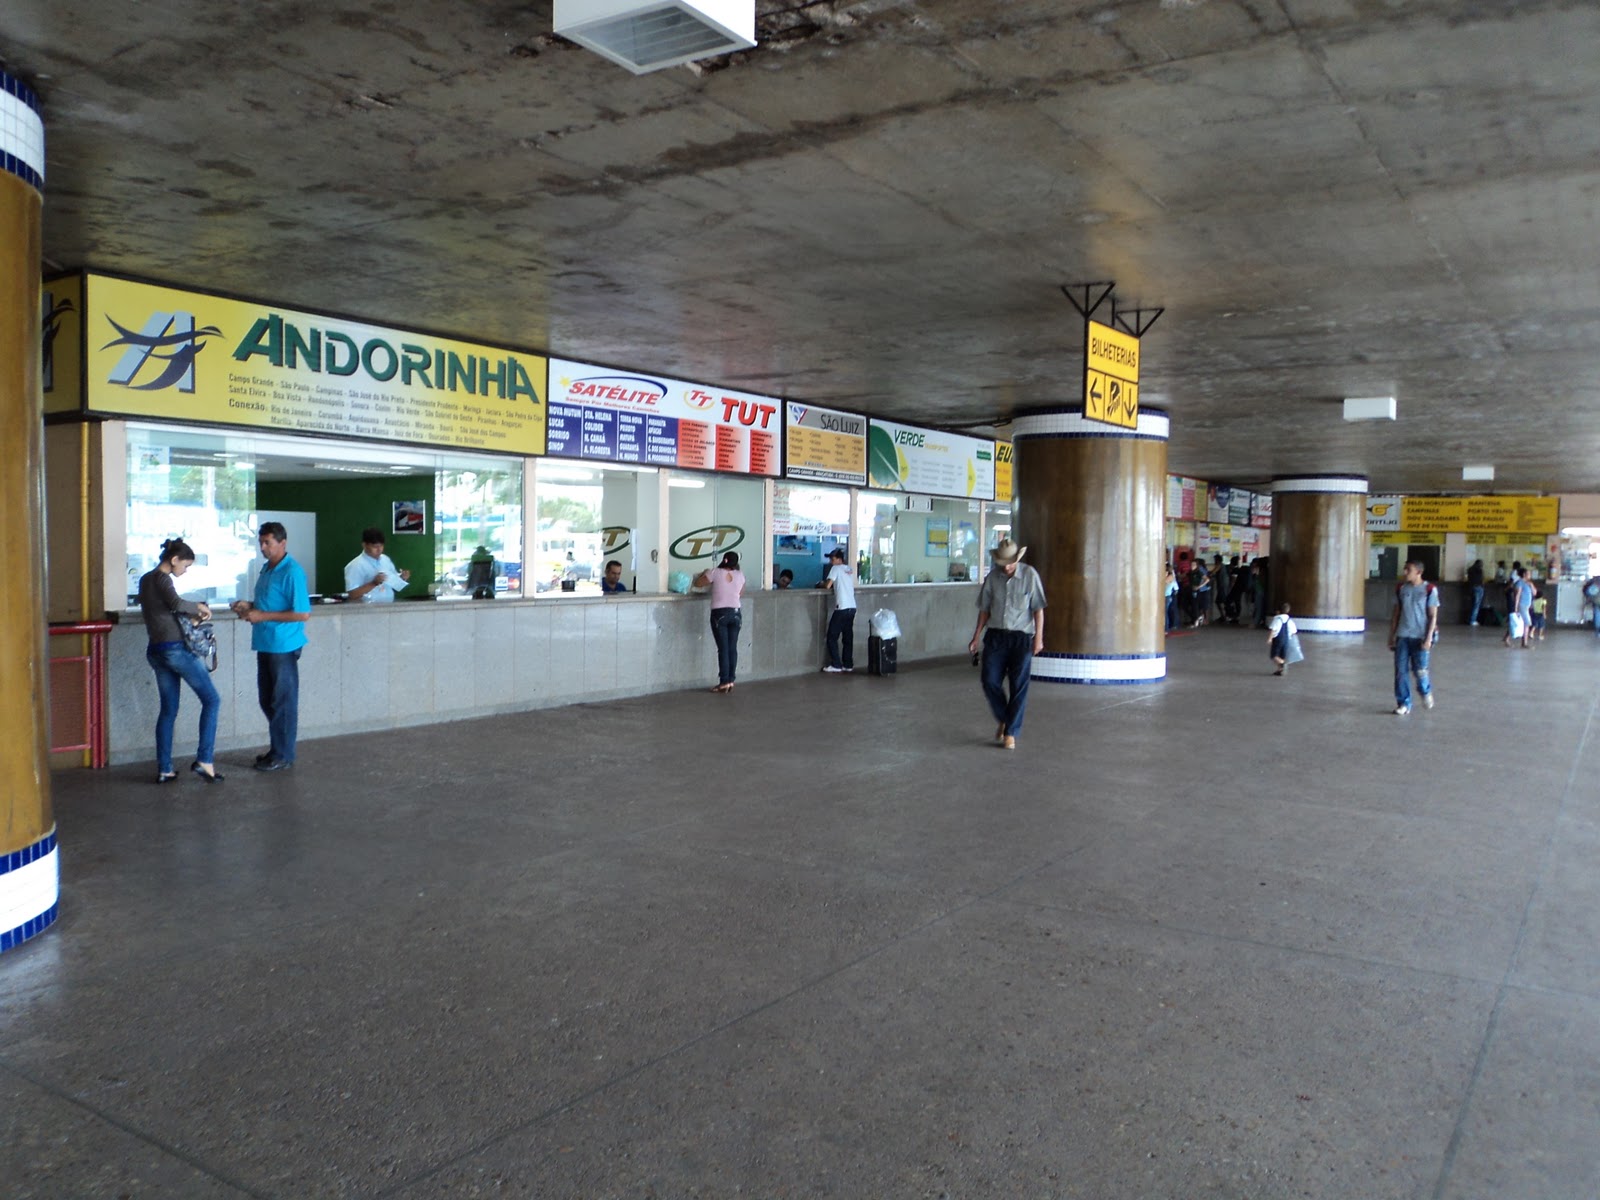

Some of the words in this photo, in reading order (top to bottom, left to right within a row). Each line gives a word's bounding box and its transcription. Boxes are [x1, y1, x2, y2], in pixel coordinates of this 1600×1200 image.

[232, 313, 540, 404] ANDORINHA
[1092, 337, 1136, 368] BILHETERIAS
[228, 385, 247, 394] Santa
[250, 387, 266, 397] Elvira
[273, 390, 284, 399] Boa
[286, 392, 300, 402] Vista
[229, 373, 250, 384] Campo
[252, 376, 274, 386] Grande
[281, 381, 291, 389] São
[294, 382, 310, 392] Paulo
[316, 386, 342, 396] Campinas
[410, 398, 436, 407] Presidente
[437, 401, 458, 410] Prudente
[569, 382, 660, 405] SATÉLITE
[549, 417, 564, 428] LUCAS
[721, 397, 777, 429] TUT
[820, 414, 840, 432] SÃO
[840, 416, 860, 435] LUIZ
[894, 430, 926, 448] VERDE
[997, 446, 1012, 464] EU
